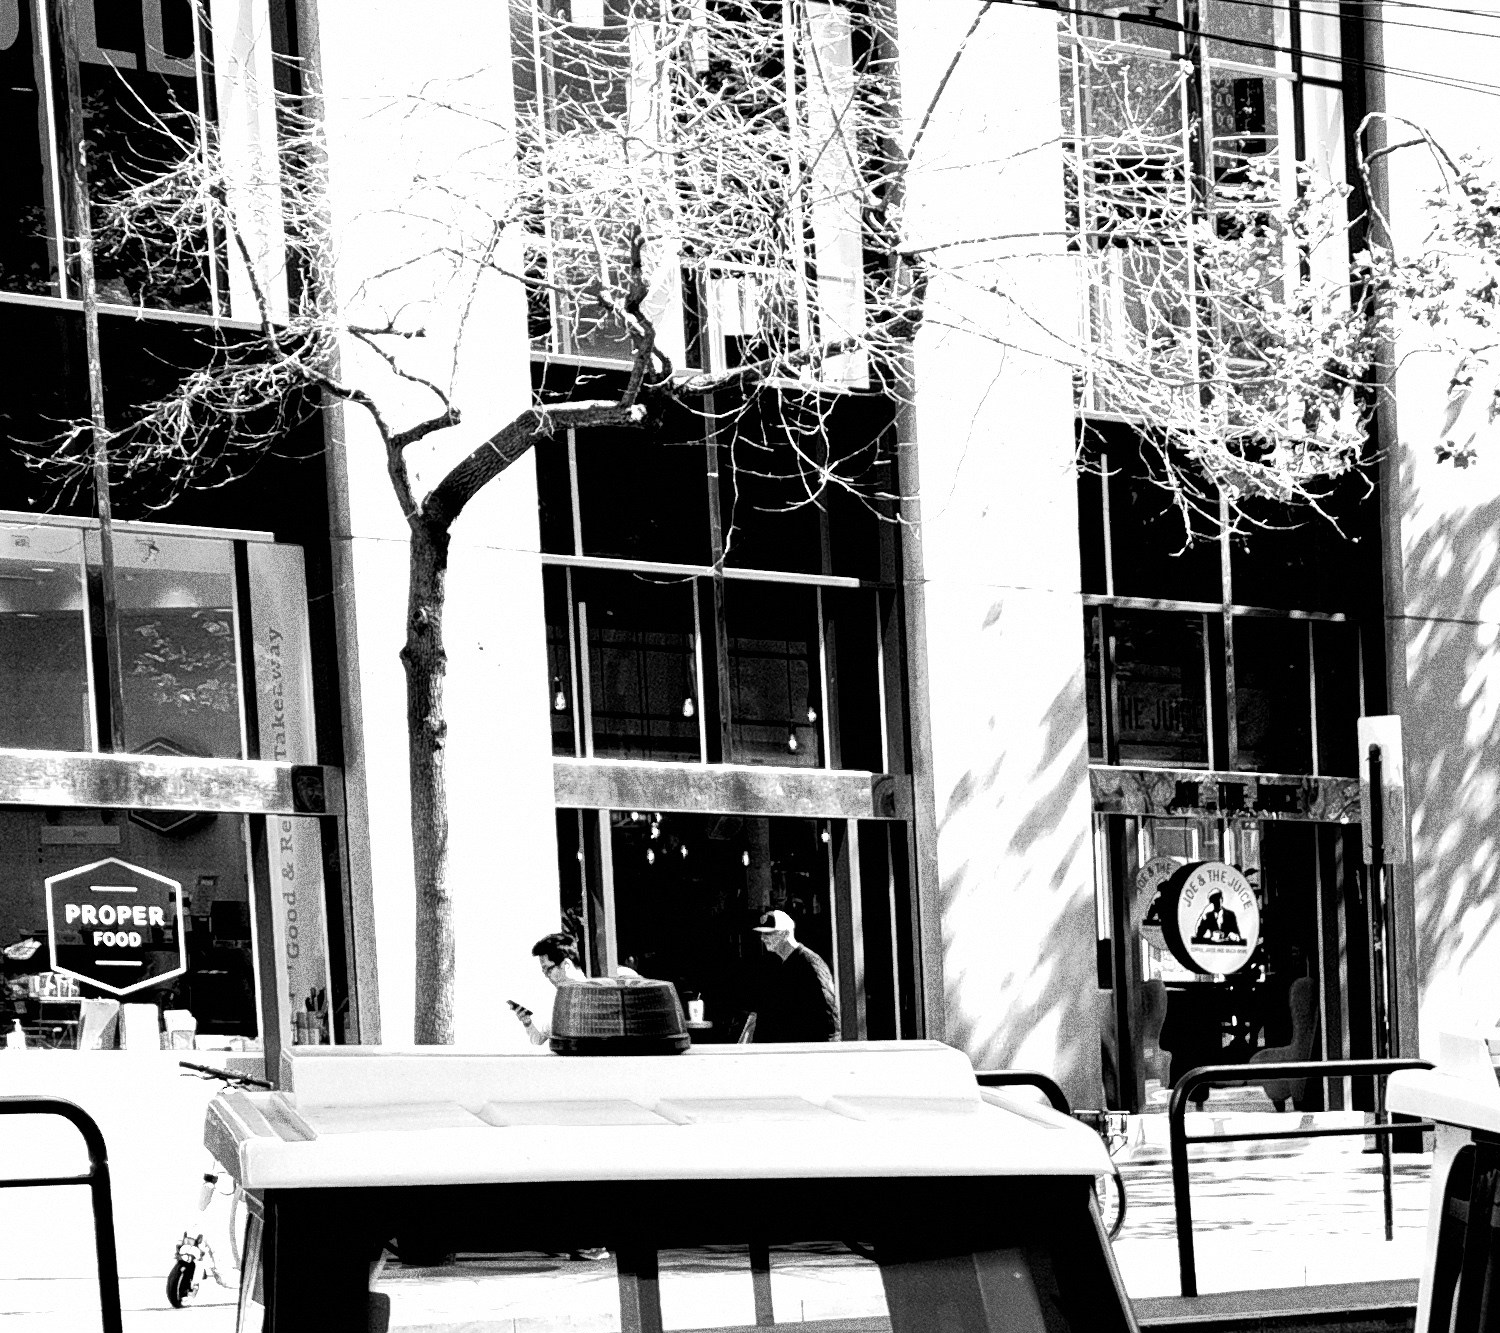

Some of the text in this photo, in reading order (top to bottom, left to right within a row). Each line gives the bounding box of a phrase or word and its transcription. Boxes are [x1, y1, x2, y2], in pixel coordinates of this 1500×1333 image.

[1183, 869, 1254, 911] JOE & THE JUICE
[64, 903, 166, 926] PROPER
[93, 931, 142, 947] FOOD
